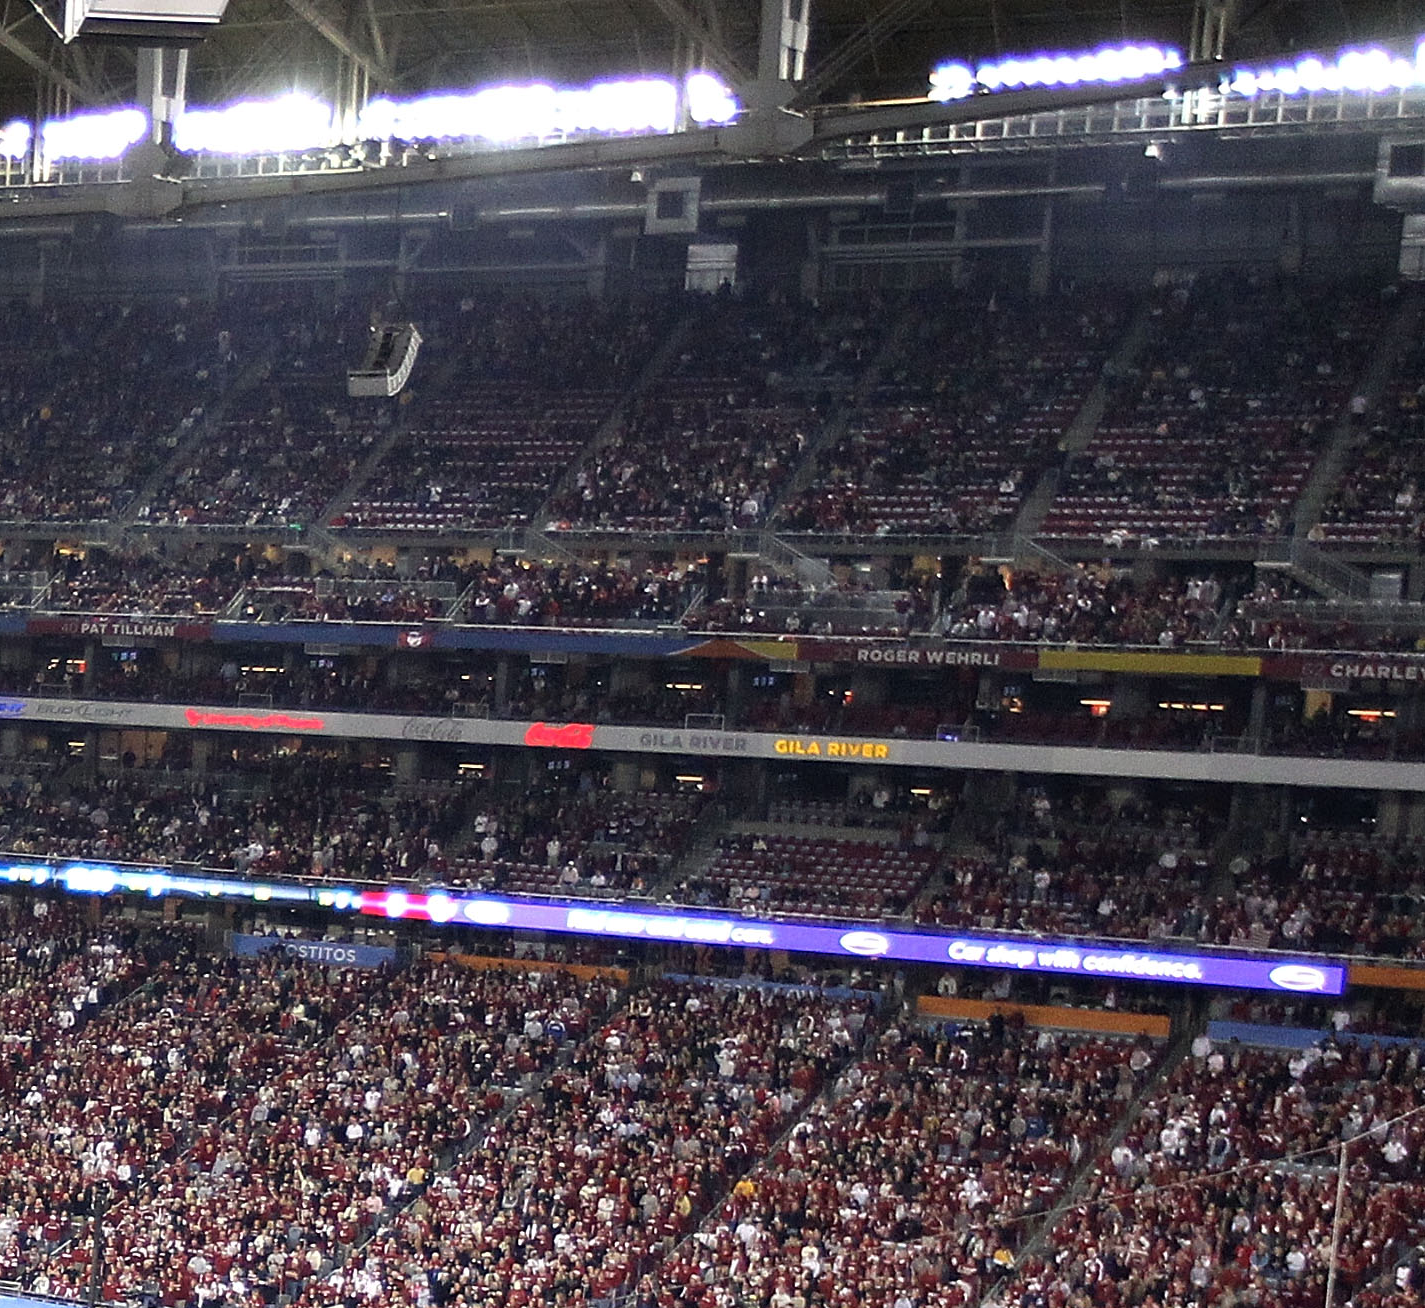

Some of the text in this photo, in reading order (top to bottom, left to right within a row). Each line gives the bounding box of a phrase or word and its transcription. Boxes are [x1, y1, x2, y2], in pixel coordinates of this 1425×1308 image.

[80, 624, 109, 635] PAT
[111, 624, 175, 637] TILLMAN
[857, 650, 920, 663] ROGER
[925, 650, 1001, 666] WEHRLI
[773, 738, 889, 759] GILA RIVER
[948, 941, 985, 960] Car
